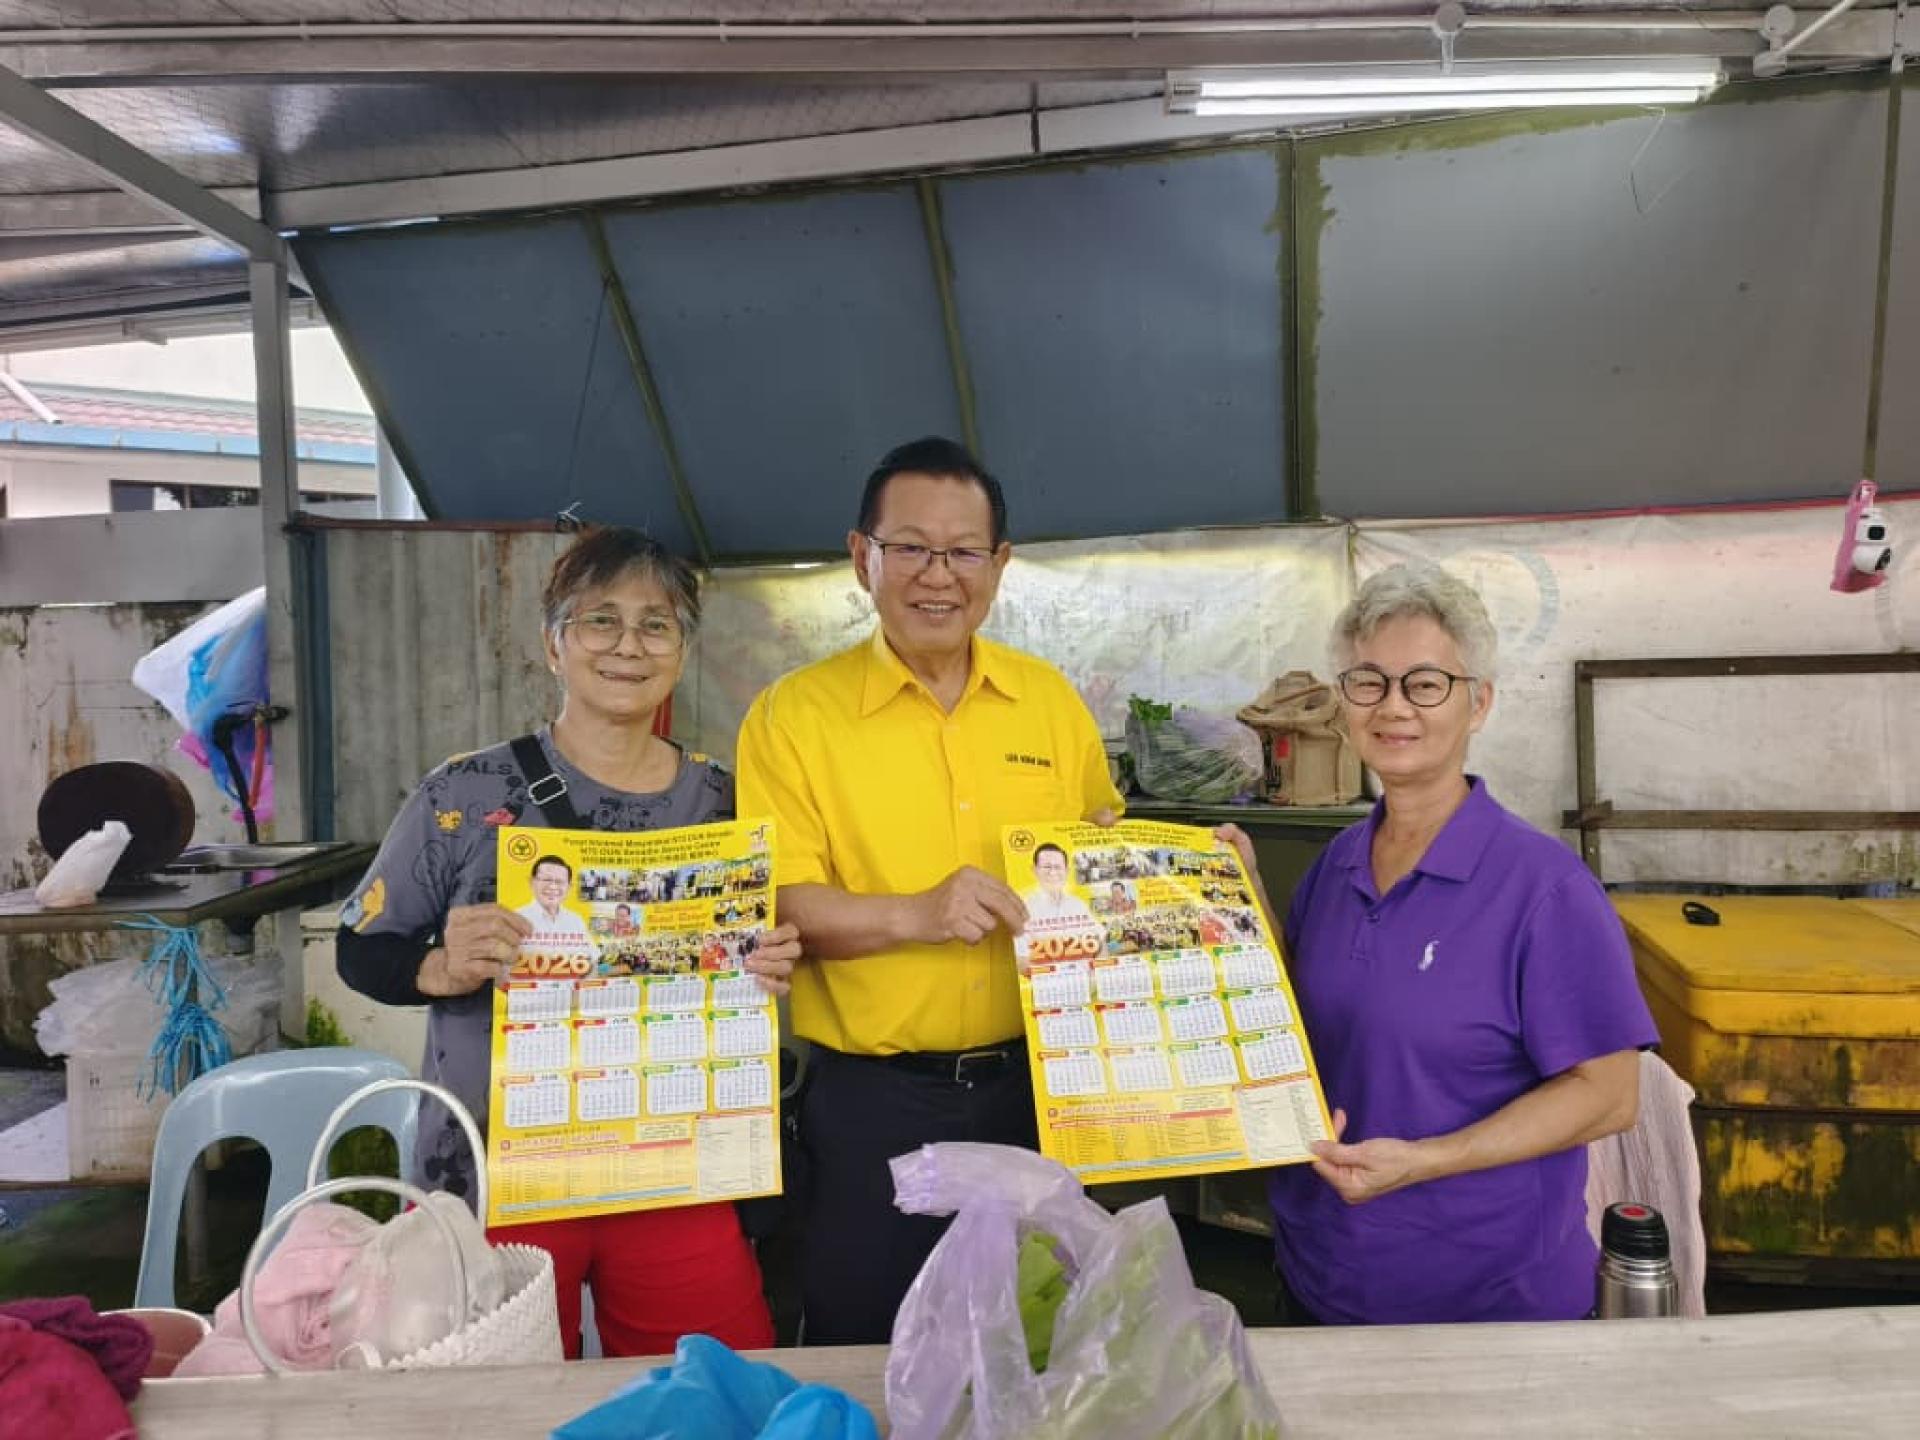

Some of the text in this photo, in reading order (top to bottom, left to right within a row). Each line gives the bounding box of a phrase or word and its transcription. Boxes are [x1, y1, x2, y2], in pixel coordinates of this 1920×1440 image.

[447, 760, 513, 776] PALS
[1029, 932, 1102, 960] 2026
[511, 952, 592, 976] 2026
